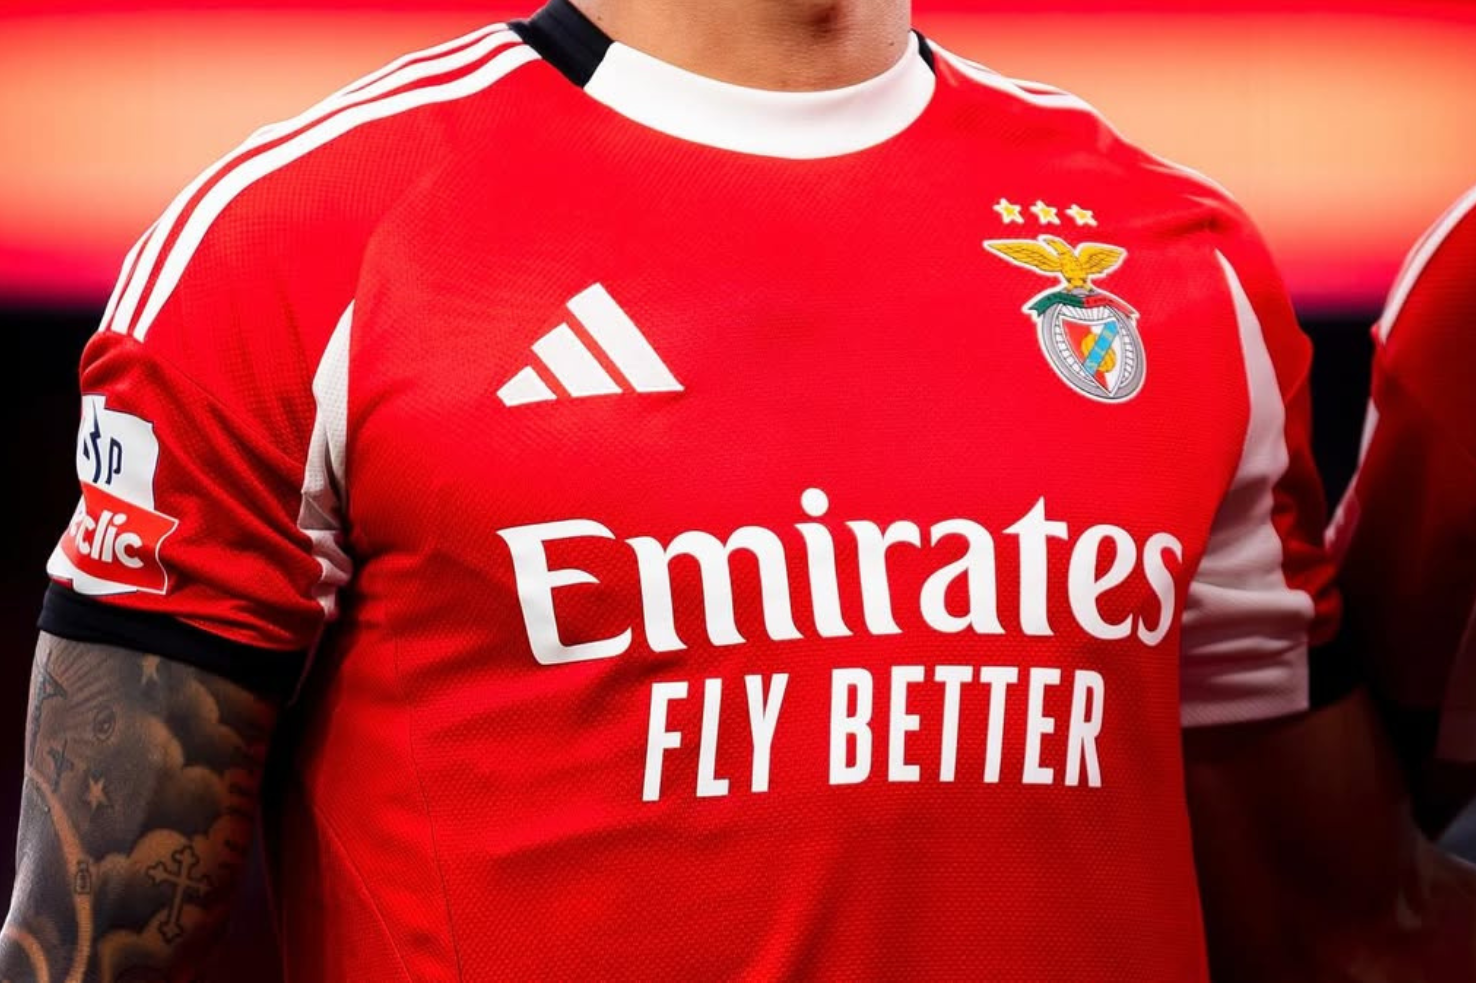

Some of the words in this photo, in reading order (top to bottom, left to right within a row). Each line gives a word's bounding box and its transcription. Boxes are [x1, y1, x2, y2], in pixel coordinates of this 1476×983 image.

[496, 487, 1183, 665] Emirates
[641, 673, 789, 802] FLY
[828, 665, 1104, 787] BETTER
